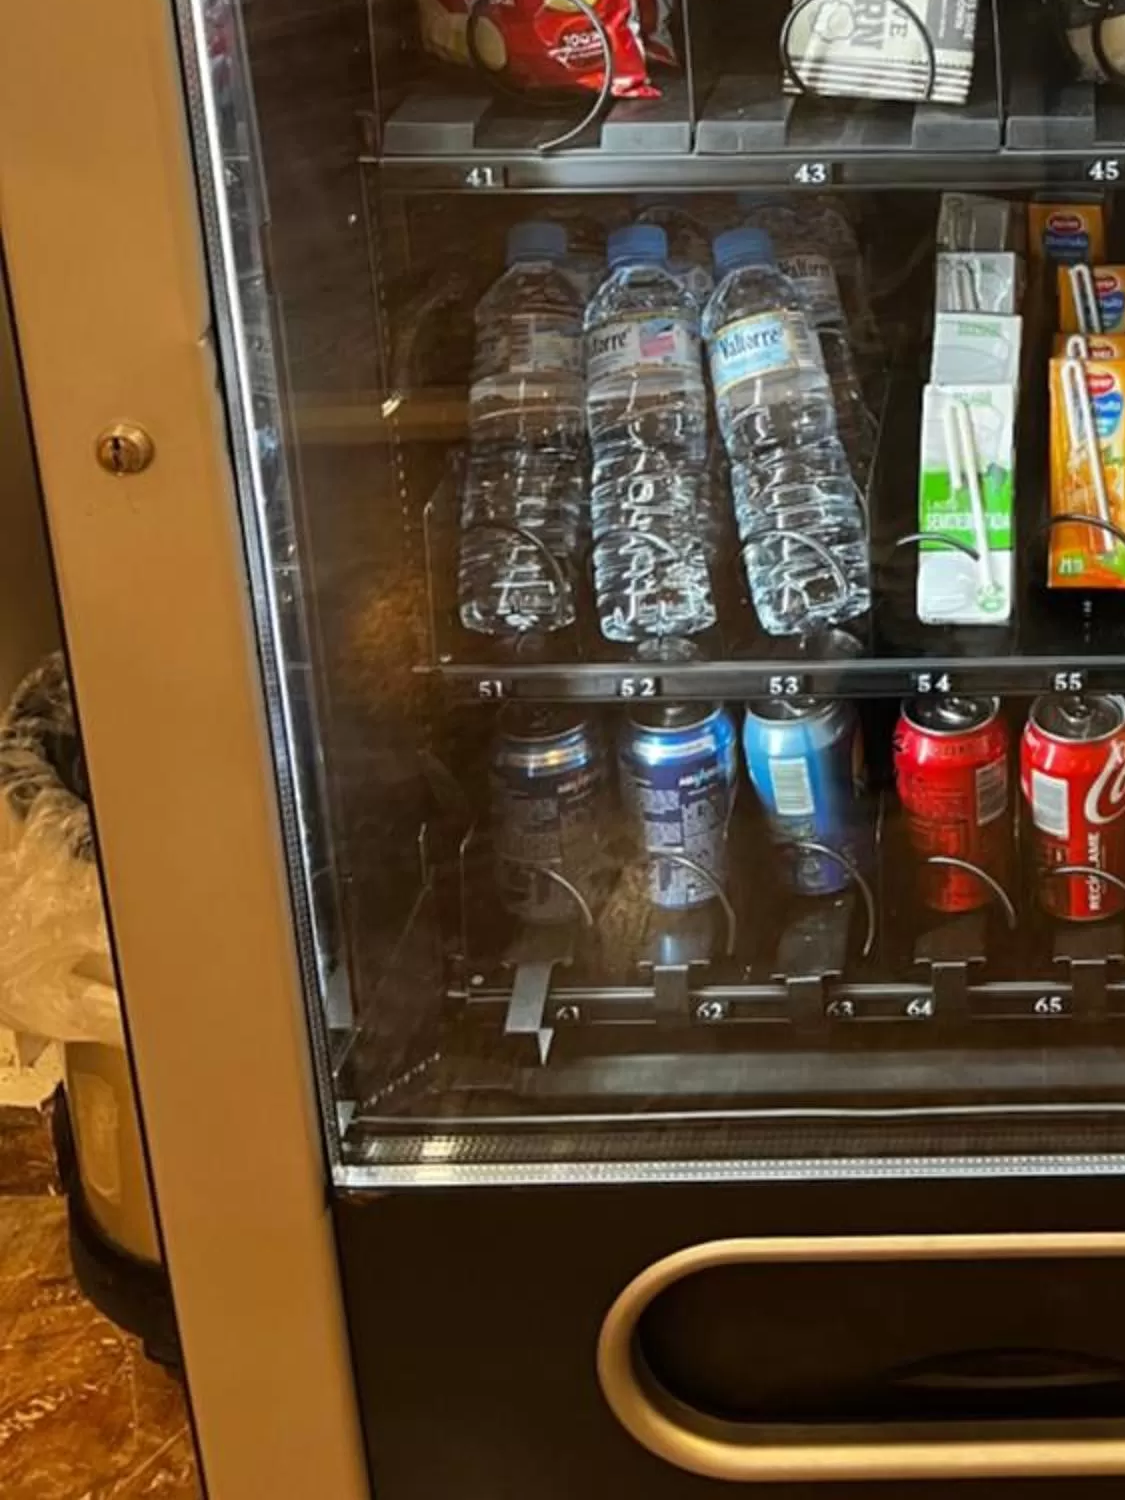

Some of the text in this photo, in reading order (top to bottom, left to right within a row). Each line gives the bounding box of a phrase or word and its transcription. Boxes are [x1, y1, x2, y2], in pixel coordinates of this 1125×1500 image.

[465, 167, 496, 188] 41
[794, 164, 827, 185] 43
[1088, 161, 1121, 182] 45
[718, 323, 784, 361] Valtorre
[478, 680, 503, 698] 51
[620, 678, 655, 697] 52
[768, 675, 799, 695] 53
[916, 673, 951, 694] 54
[1054, 672, 1084, 692] 55
[697, 1002, 724, 1021] 62
[826, 1000, 855, 1017] 63
[906, 998, 934, 1017] 64
[1034, 996, 1063, 1014] 65
